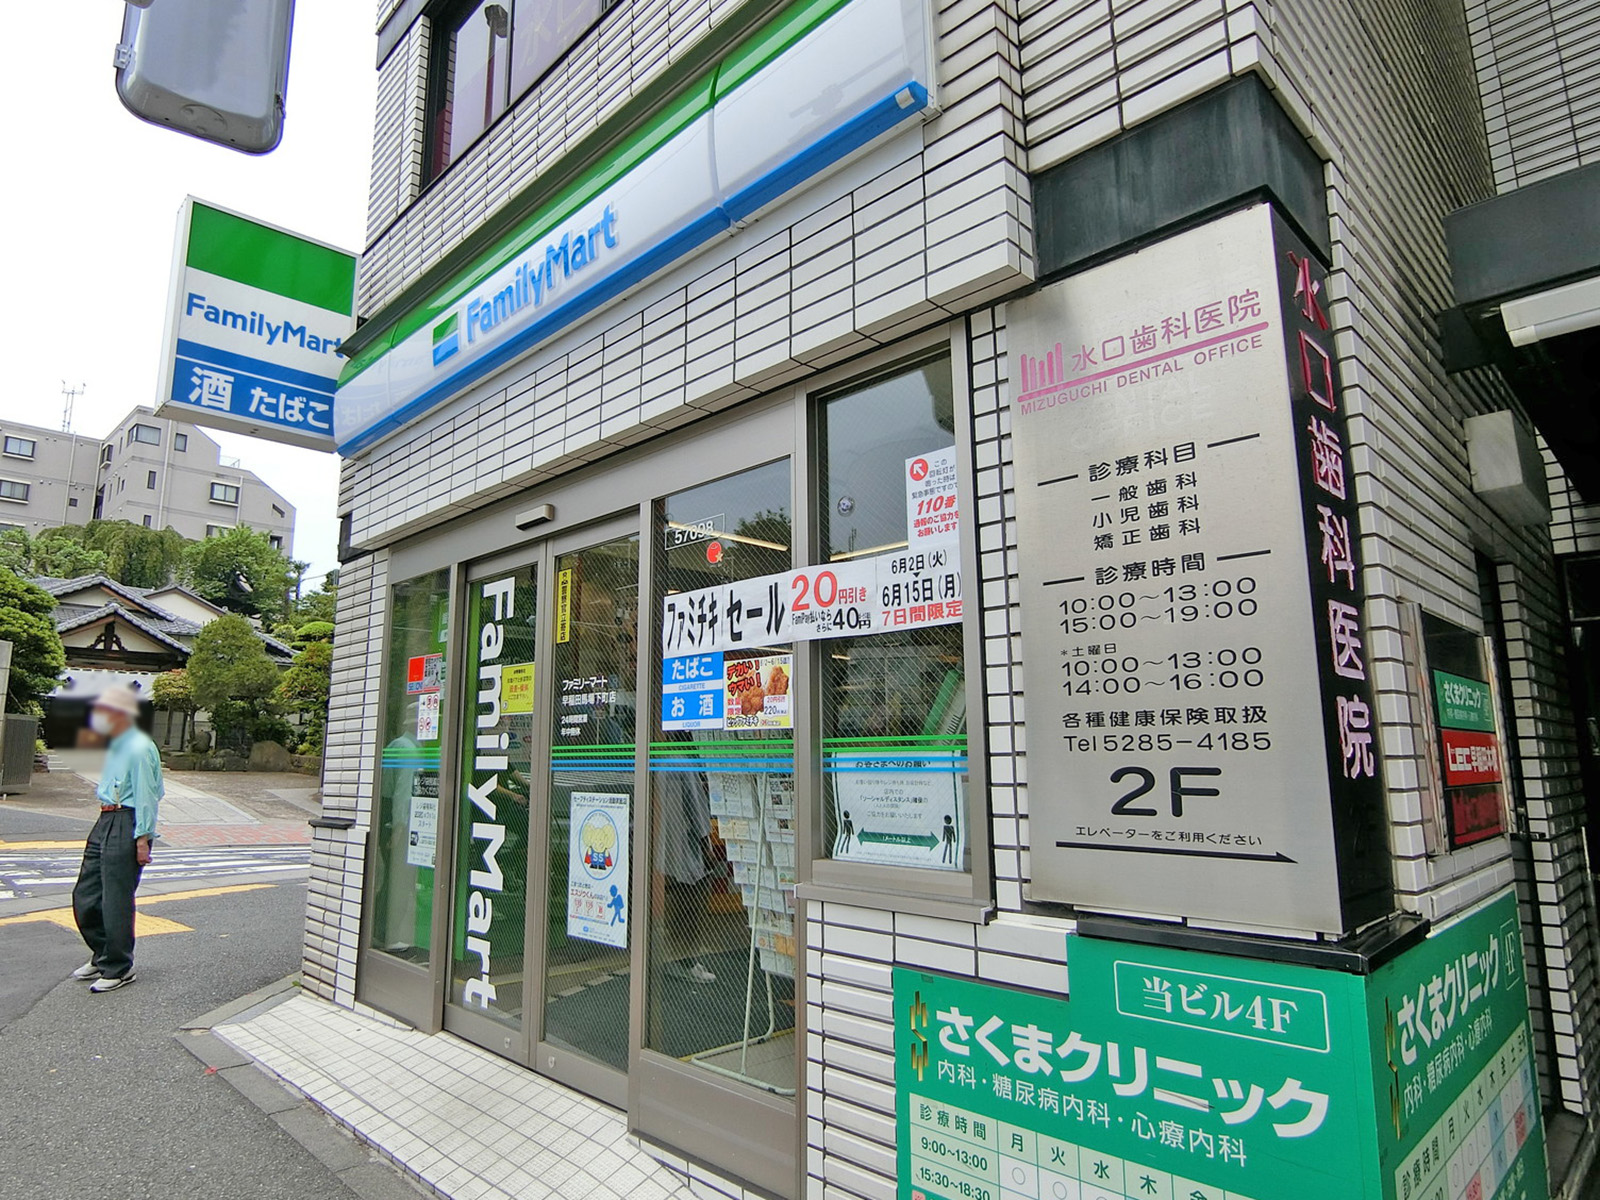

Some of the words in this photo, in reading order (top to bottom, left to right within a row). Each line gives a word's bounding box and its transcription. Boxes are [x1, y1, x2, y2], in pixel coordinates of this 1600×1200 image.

[467, 203, 617, 343] FamilyMart
[186, 292, 344, 358] FamilyMart
[1071, 288, 1262, 372] 水口歯科医院
[189, 366, 235, 411] 酒
[249, 387, 330, 429] たばこ
[1020, 381, 1108, 416] MIZUGUCHI
[1117, 359, 1184, 388] DENTAL
[1194, 334, 1263, 366] OFFICE
[1088, 442, 1196, 482] 診療科目
[917, 495, 956, 516] 110番
[1091, 471, 1198, 502] 一般歯科
[674, 520, 714, 544] 57098
[1092, 494, 1199, 529] 小児歯科
[1093, 517, 1201, 551] 矯正歯科
[1287, 251, 1374, 778] 水口歯科医院
[1095, 551, 1205, 586] 診療時間
[882, 600, 963, 627] 7日間限定
[562, 675, 608, 692] ファミリーマート
[671, 655, 714, 681] たばこ
[1062, 705, 1269, 729] 各種健康保険取扱
[463, 576, 516, 1010] FamilyMart
[1110, 766, 1222, 818] 2F
[1075, 825, 1263, 847] エレベーターをご利用ください
[1141, 975, 1298, 1035] 当ビル4F
[1397, 934, 1499, 1066] さくまクリニック
[935, 1005, 1330, 1139] さくまクリニック
[920, 1103, 988, 1141] 診療時間
[1011, 1133, 1024, 1152] 月
[1050, 1145, 1067, 1163] 火
[1093, 1160, 1110, 1179] 水
[1139, 1174, 1158, 1195] 木
